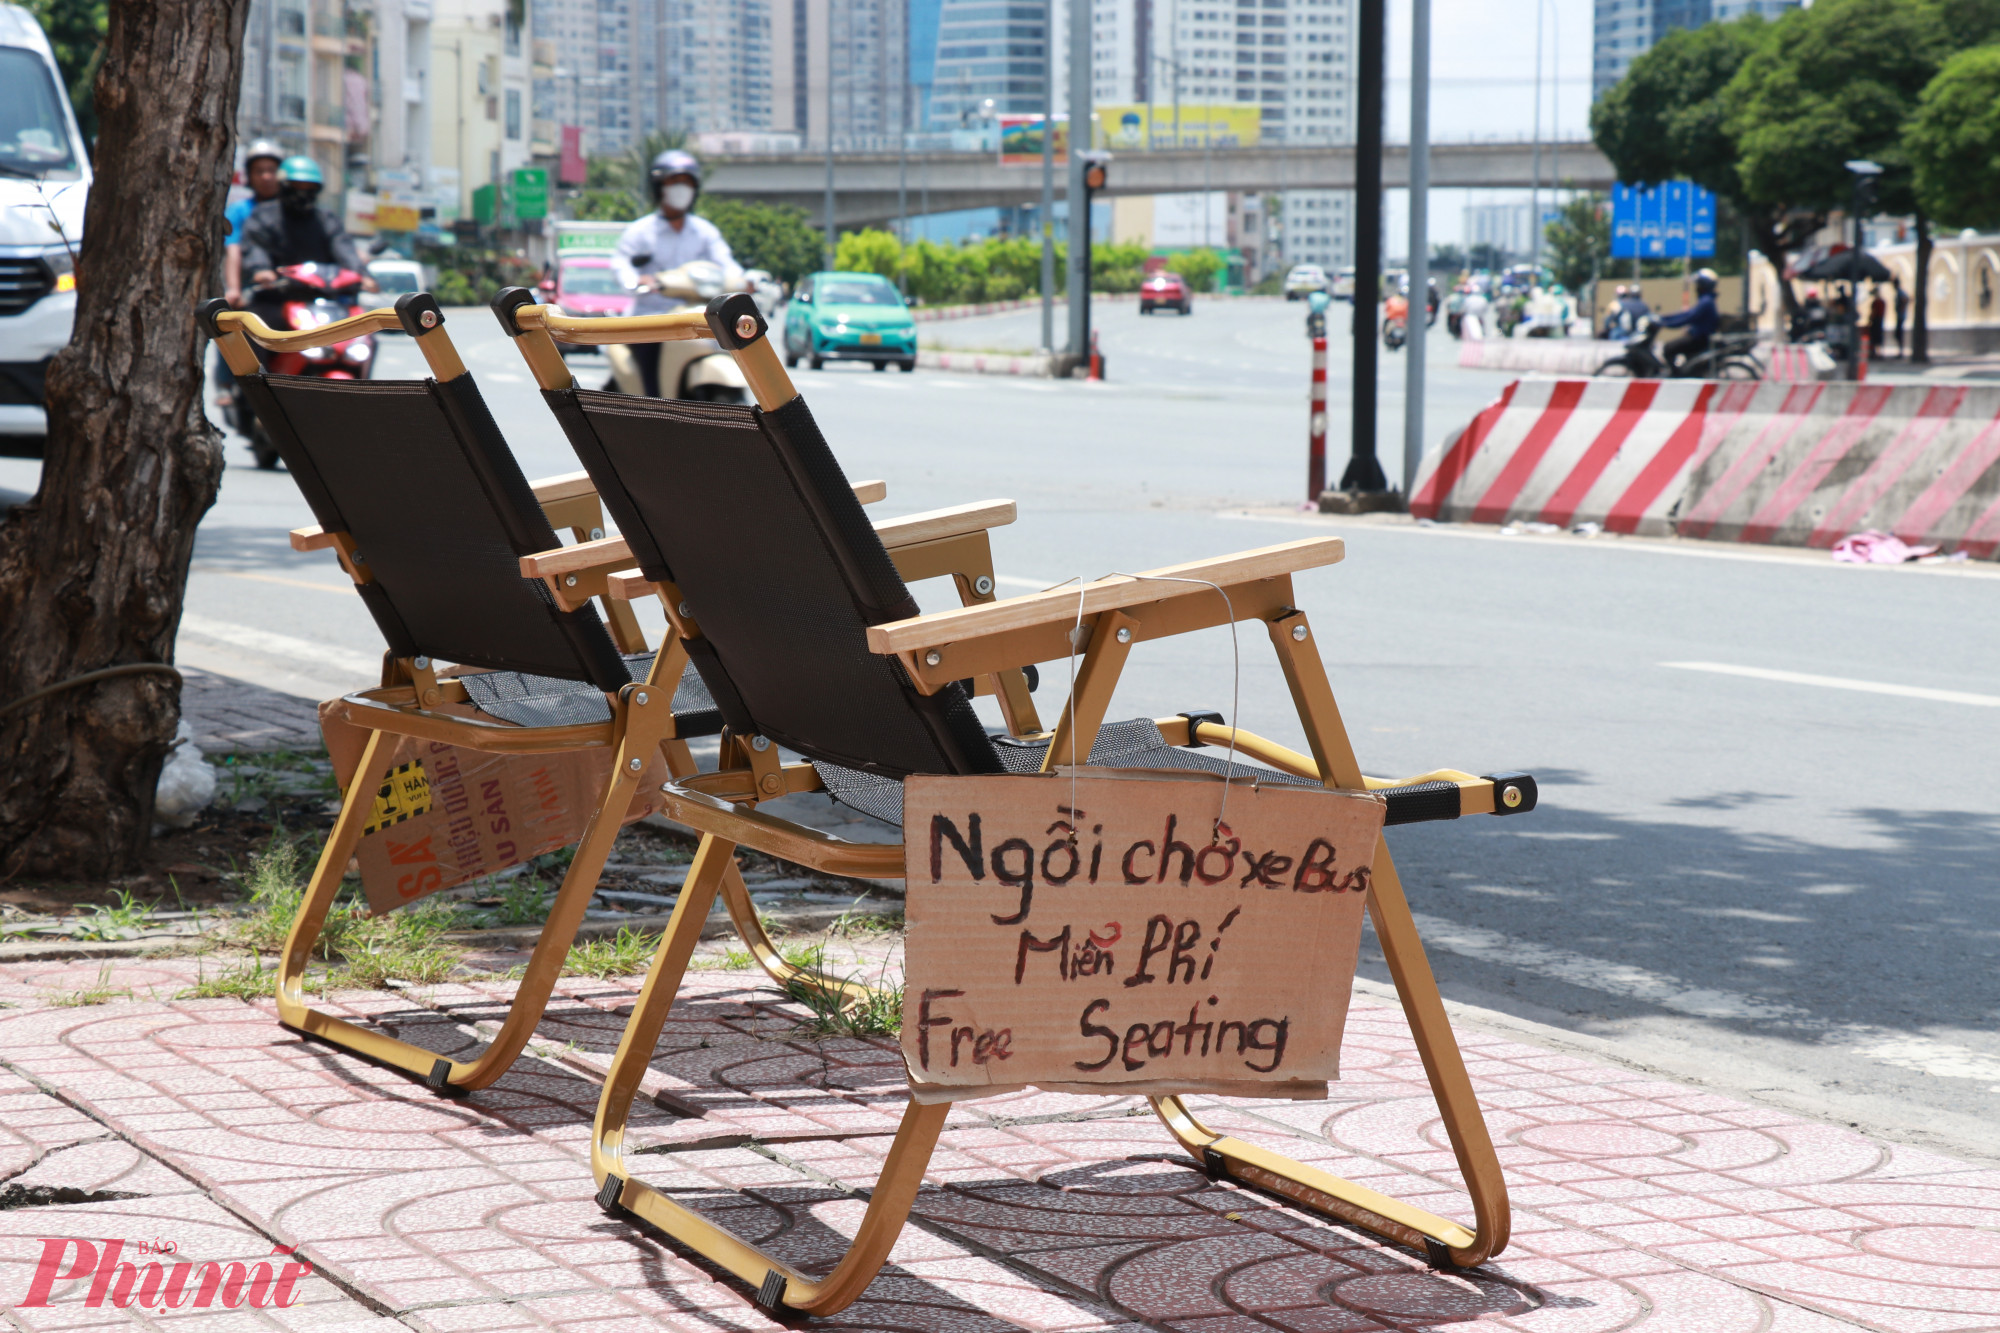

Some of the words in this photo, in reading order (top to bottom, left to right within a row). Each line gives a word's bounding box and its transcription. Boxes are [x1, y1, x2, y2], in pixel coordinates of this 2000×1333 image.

[480, 779, 510, 834] SÀN
[496, 841, 518, 866] U
[930, 805, 1103, 926] Ngồi
[1122, 813, 1240, 886] chờ
[1240, 850, 1294, 889] xe
[1293, 837, 1371, 893] Bus
[1014, 921, 1122, 985] Miễn
[917, 988, 1014, 1072] Free
[1072, 994, 1289, 1073] Seating
